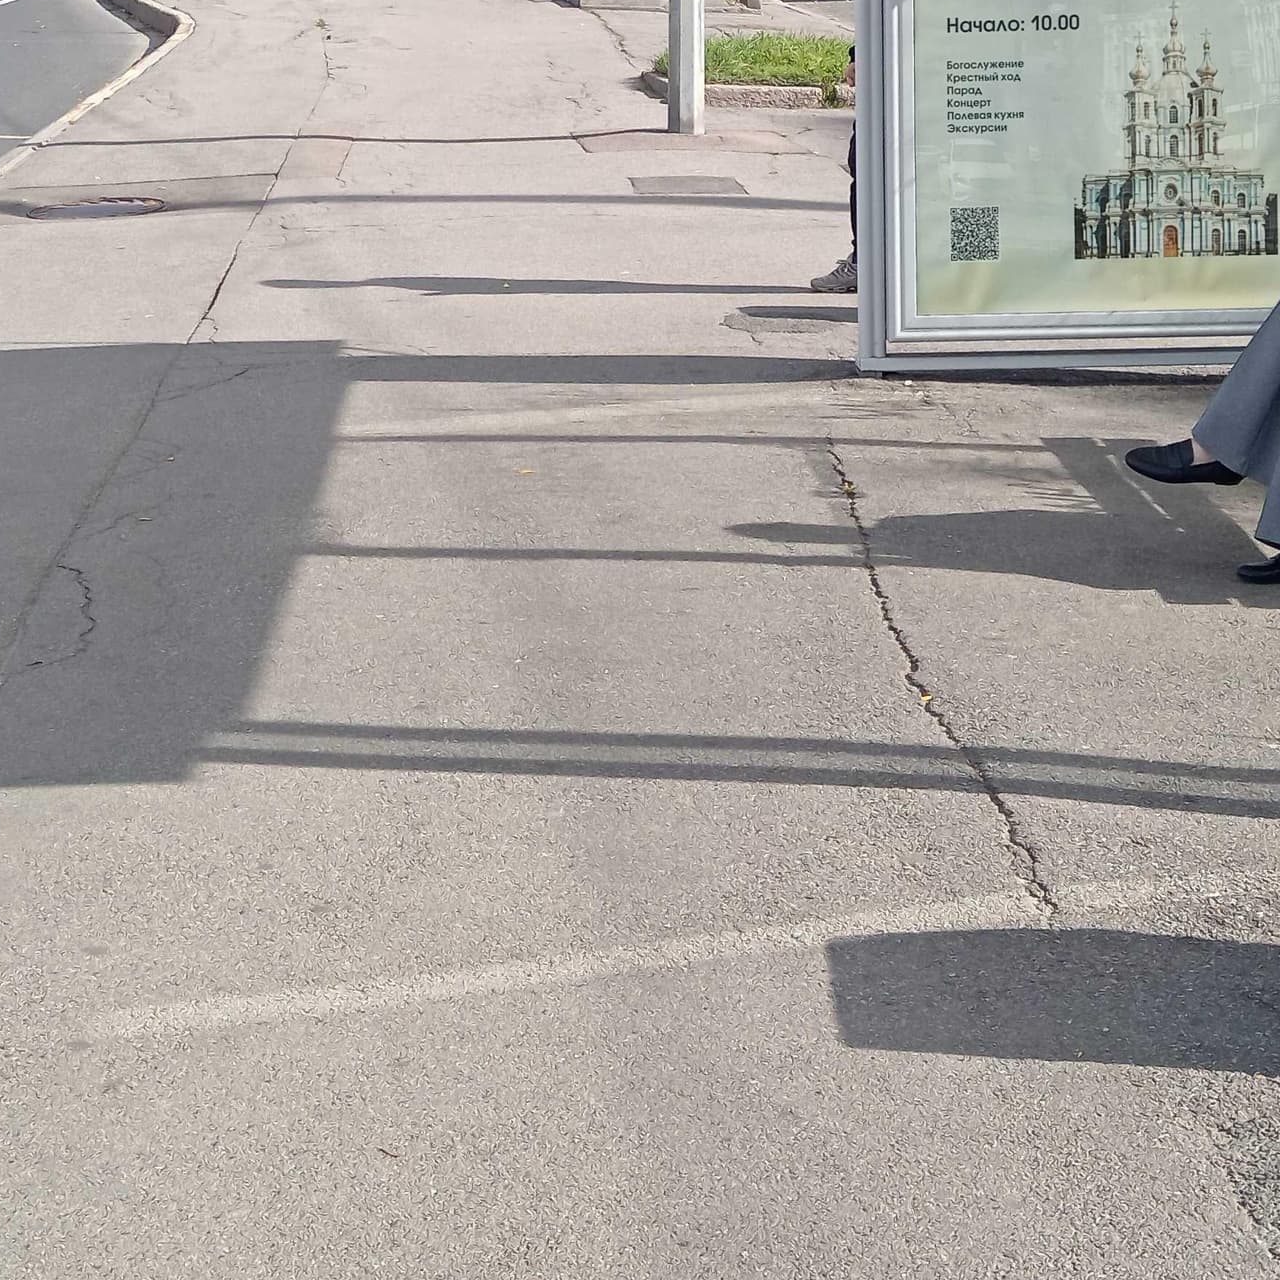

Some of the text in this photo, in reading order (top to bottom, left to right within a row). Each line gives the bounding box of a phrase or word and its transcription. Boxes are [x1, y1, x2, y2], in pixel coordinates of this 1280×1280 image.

[946, 14, 1080, 33] Начало: 10.00
[946, 60, 1024, 70] Богослужение
[946, 72, 1022, 84] Крестный ход
[946, 86, 983, 96] Парад
[946, 99, 992, 109] Концерт
[947, 111, 1024, 121] Полевая кухня
[946, 123, 1008, 134] Экскурсии
